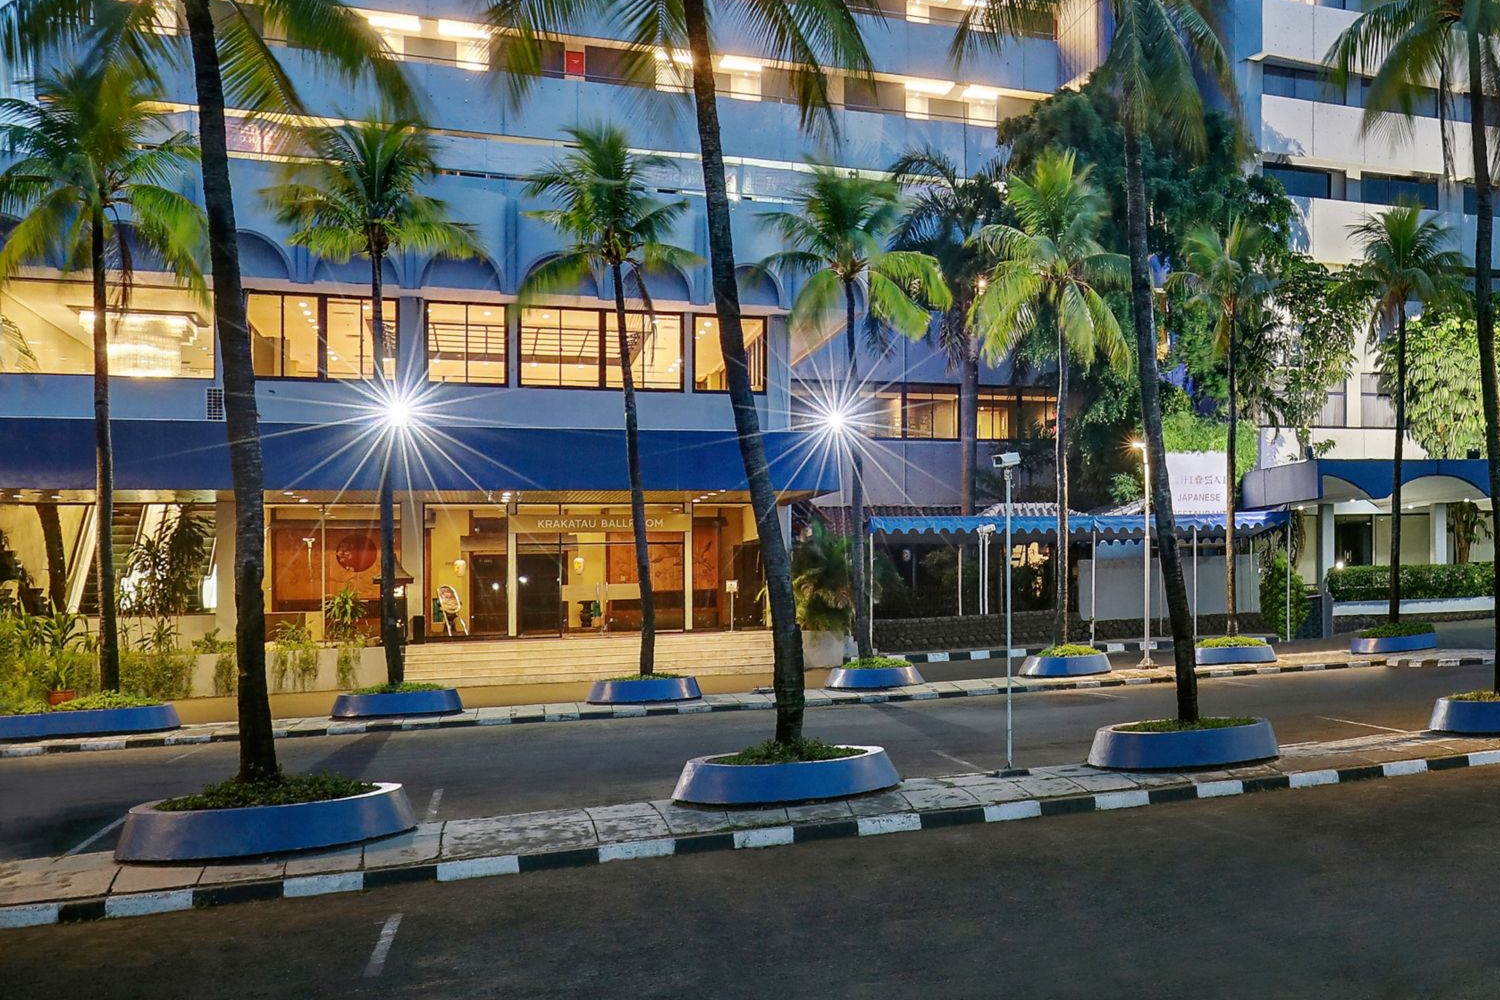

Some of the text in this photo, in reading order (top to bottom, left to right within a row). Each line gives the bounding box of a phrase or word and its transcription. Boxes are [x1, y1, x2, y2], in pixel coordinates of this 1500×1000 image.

[1177, 493, 1221, 502] JAPANESE
[537, 519, 664, 528] KRAKATAU BALLROM
